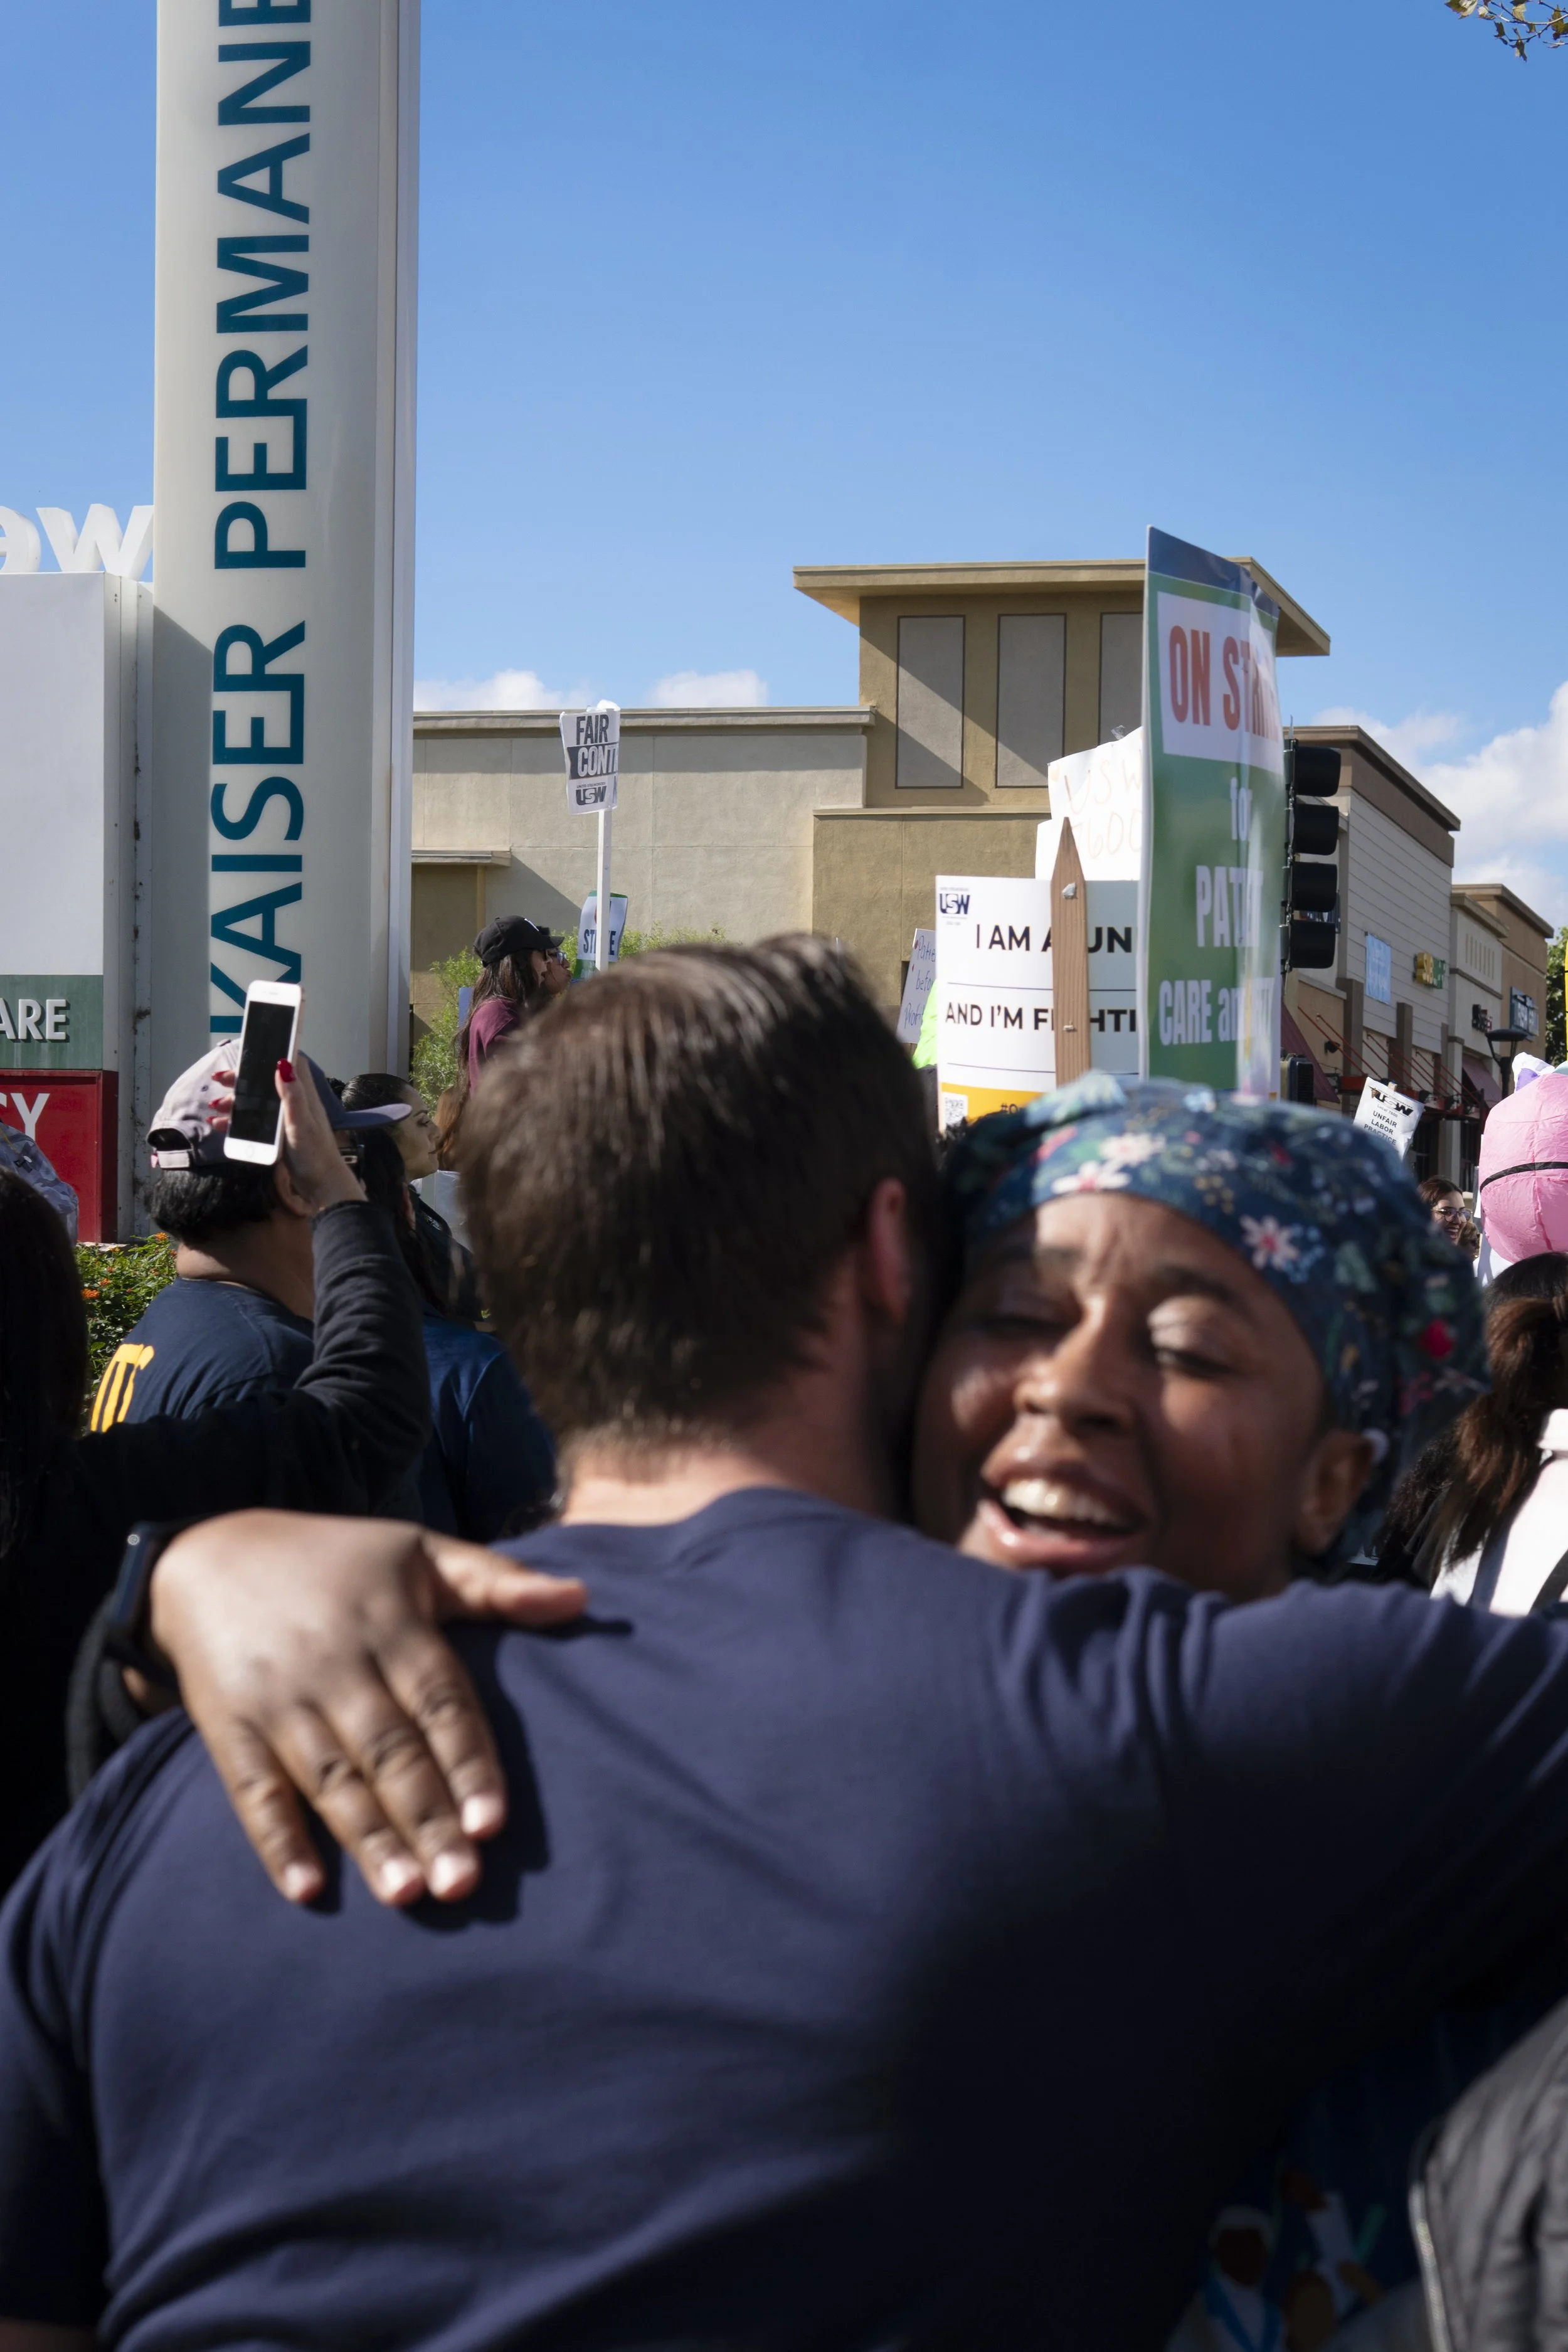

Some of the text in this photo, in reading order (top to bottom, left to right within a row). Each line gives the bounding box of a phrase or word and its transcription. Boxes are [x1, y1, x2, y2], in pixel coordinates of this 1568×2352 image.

[1169, 625, 1210, 726] ON
[576, 714, 609, 745] FAIR
[576, 786, 607, 805] USW
[209, 620, 305, 1033] KAISER
[940, 893, 970, 914] USW
[583, 929, 617, 955] STE
[977, 924, 980, 948] I
[988, 925, 1030, 951] AM
[946, 1002, 1136, 1032] AND I'M FHTI
[1158, 980, 1212, 1046] CARE
[1373, 1089, 1414, 1116] USW
[0, 1093, 50, 1140] Y
[1371, 1119, 1394, 1135] LABOR
[1372, 1110, 1397, 1128] UNFAIR
